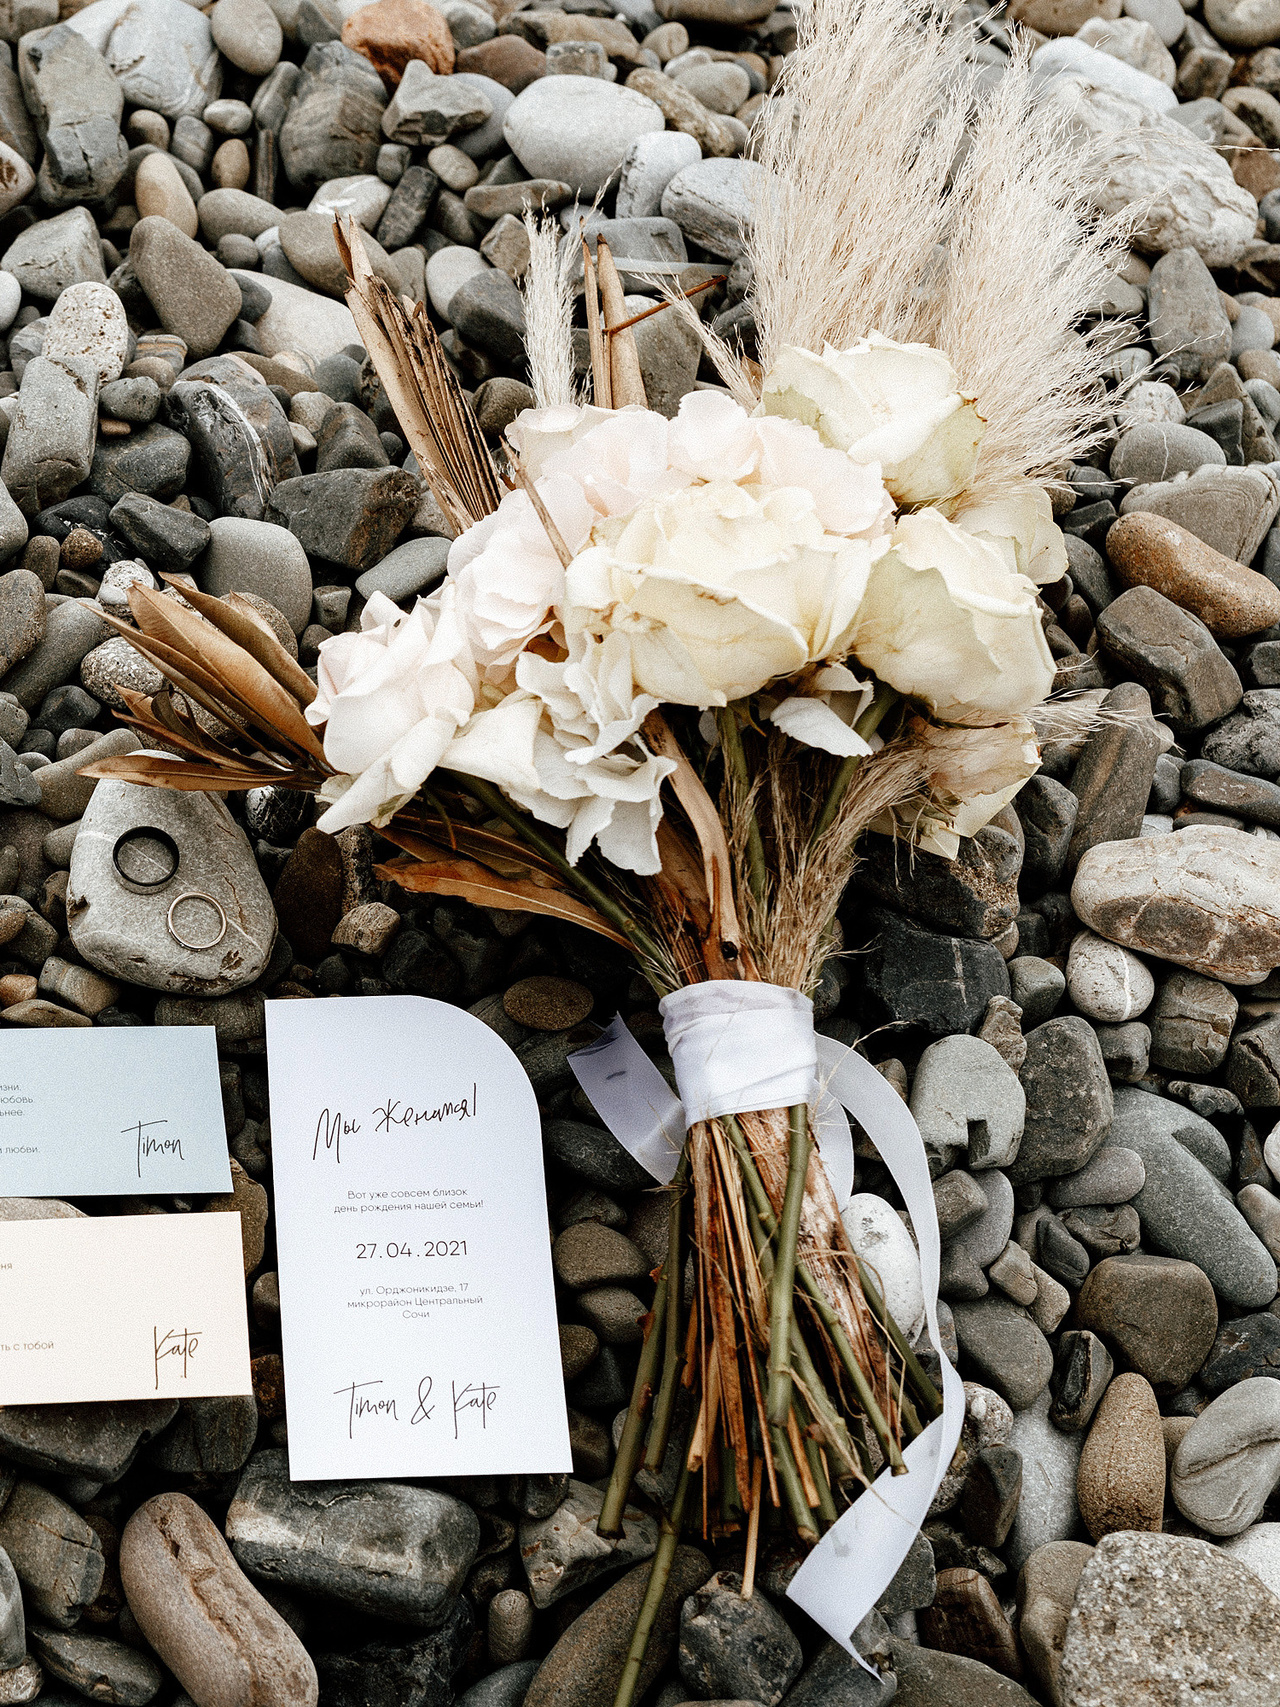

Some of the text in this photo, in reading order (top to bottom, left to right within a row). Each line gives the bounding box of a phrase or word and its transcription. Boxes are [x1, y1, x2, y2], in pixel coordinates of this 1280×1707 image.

[312, 1108, 361, 1164] Мы
[121, 1119, 184, 1178] Timon
[348, 1188, 468, 1200] Вот уже совсем близок
[334, 1200, 484, 1213] день рождения нашей семьи!
[360, 1283, 469, 1296] ул. Орджоникидзе, 17
[347, 1296, 483, 1309] микрорайон Центральный
[402, 1310, 430, 1319] Сочи
[153, 1325, 203, 1390] Kate
[333, 1376, 501, 1440] Timon & Kate
